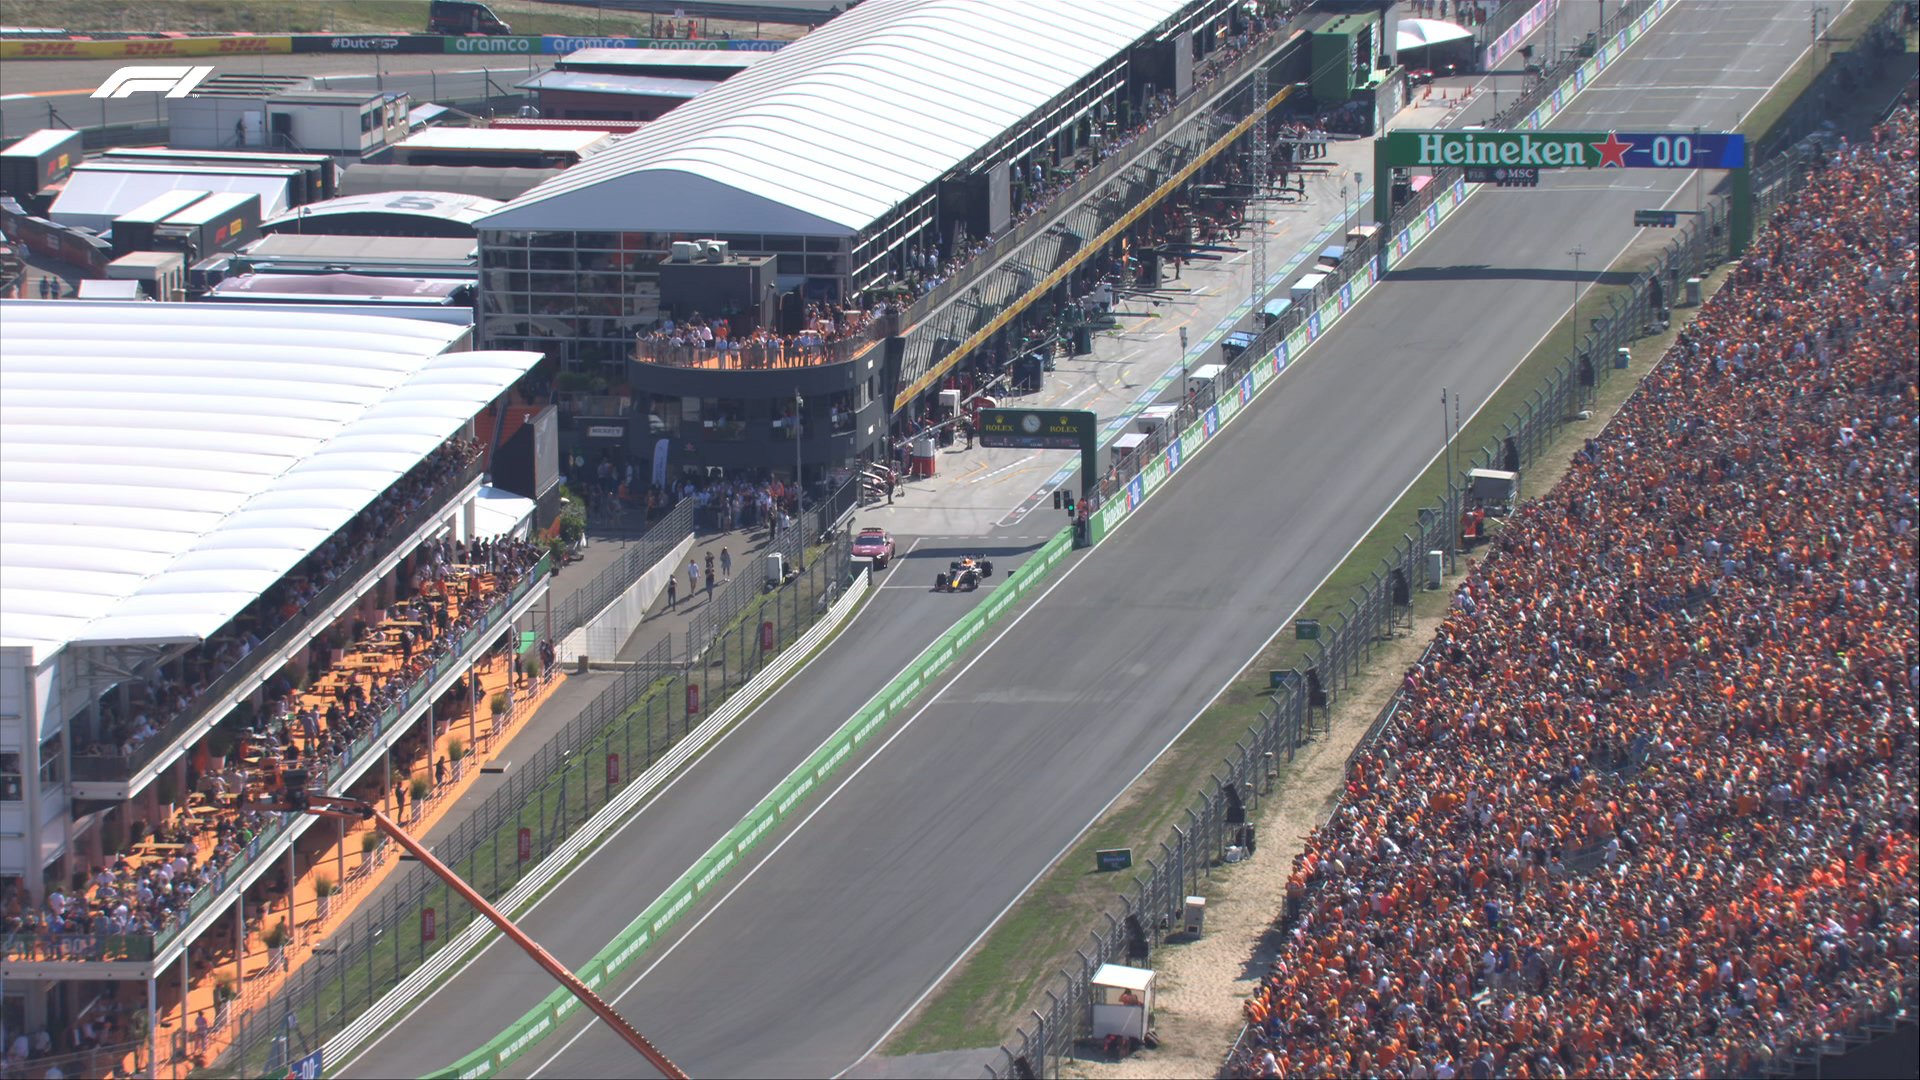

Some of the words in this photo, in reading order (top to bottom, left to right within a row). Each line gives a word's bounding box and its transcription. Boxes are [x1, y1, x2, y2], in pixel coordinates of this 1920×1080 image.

[22, 43, 77, 56] DHL
[125, 42, 176, 55] DHL
[218, 39, 268, 51] DHL
[456, 38, 529, 51] aramco
[553, 38, 626, 50] aramco
[1418, 134, 1586, 165] Heineken
[1652, 136, 1691, 166] 0.0
[1507, 168, 1534, 178] MSC
